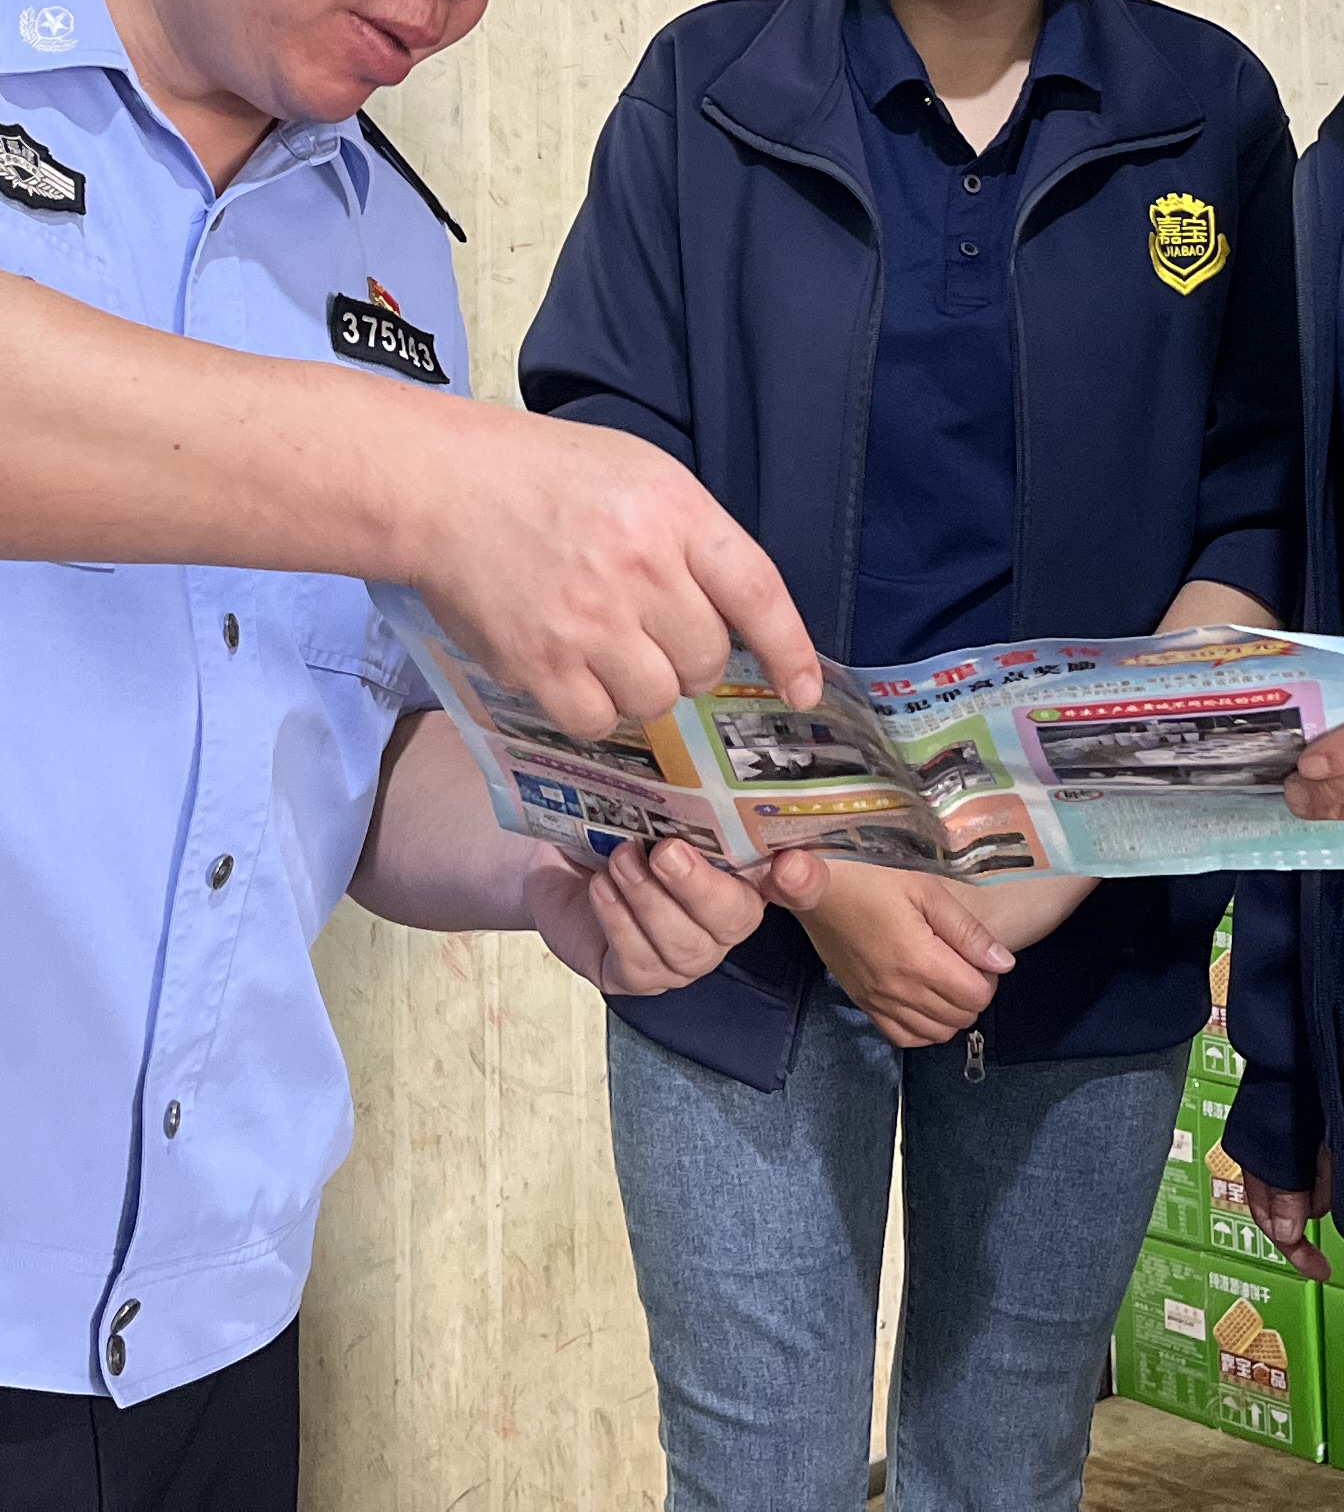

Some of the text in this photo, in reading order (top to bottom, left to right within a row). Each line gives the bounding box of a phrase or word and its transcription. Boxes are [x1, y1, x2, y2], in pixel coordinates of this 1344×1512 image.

[1157, 215, 1208, 245] 嘉宝
[1164, 244, 1205, 257] JIABAO
[342, 311, 435, 372] 375143
